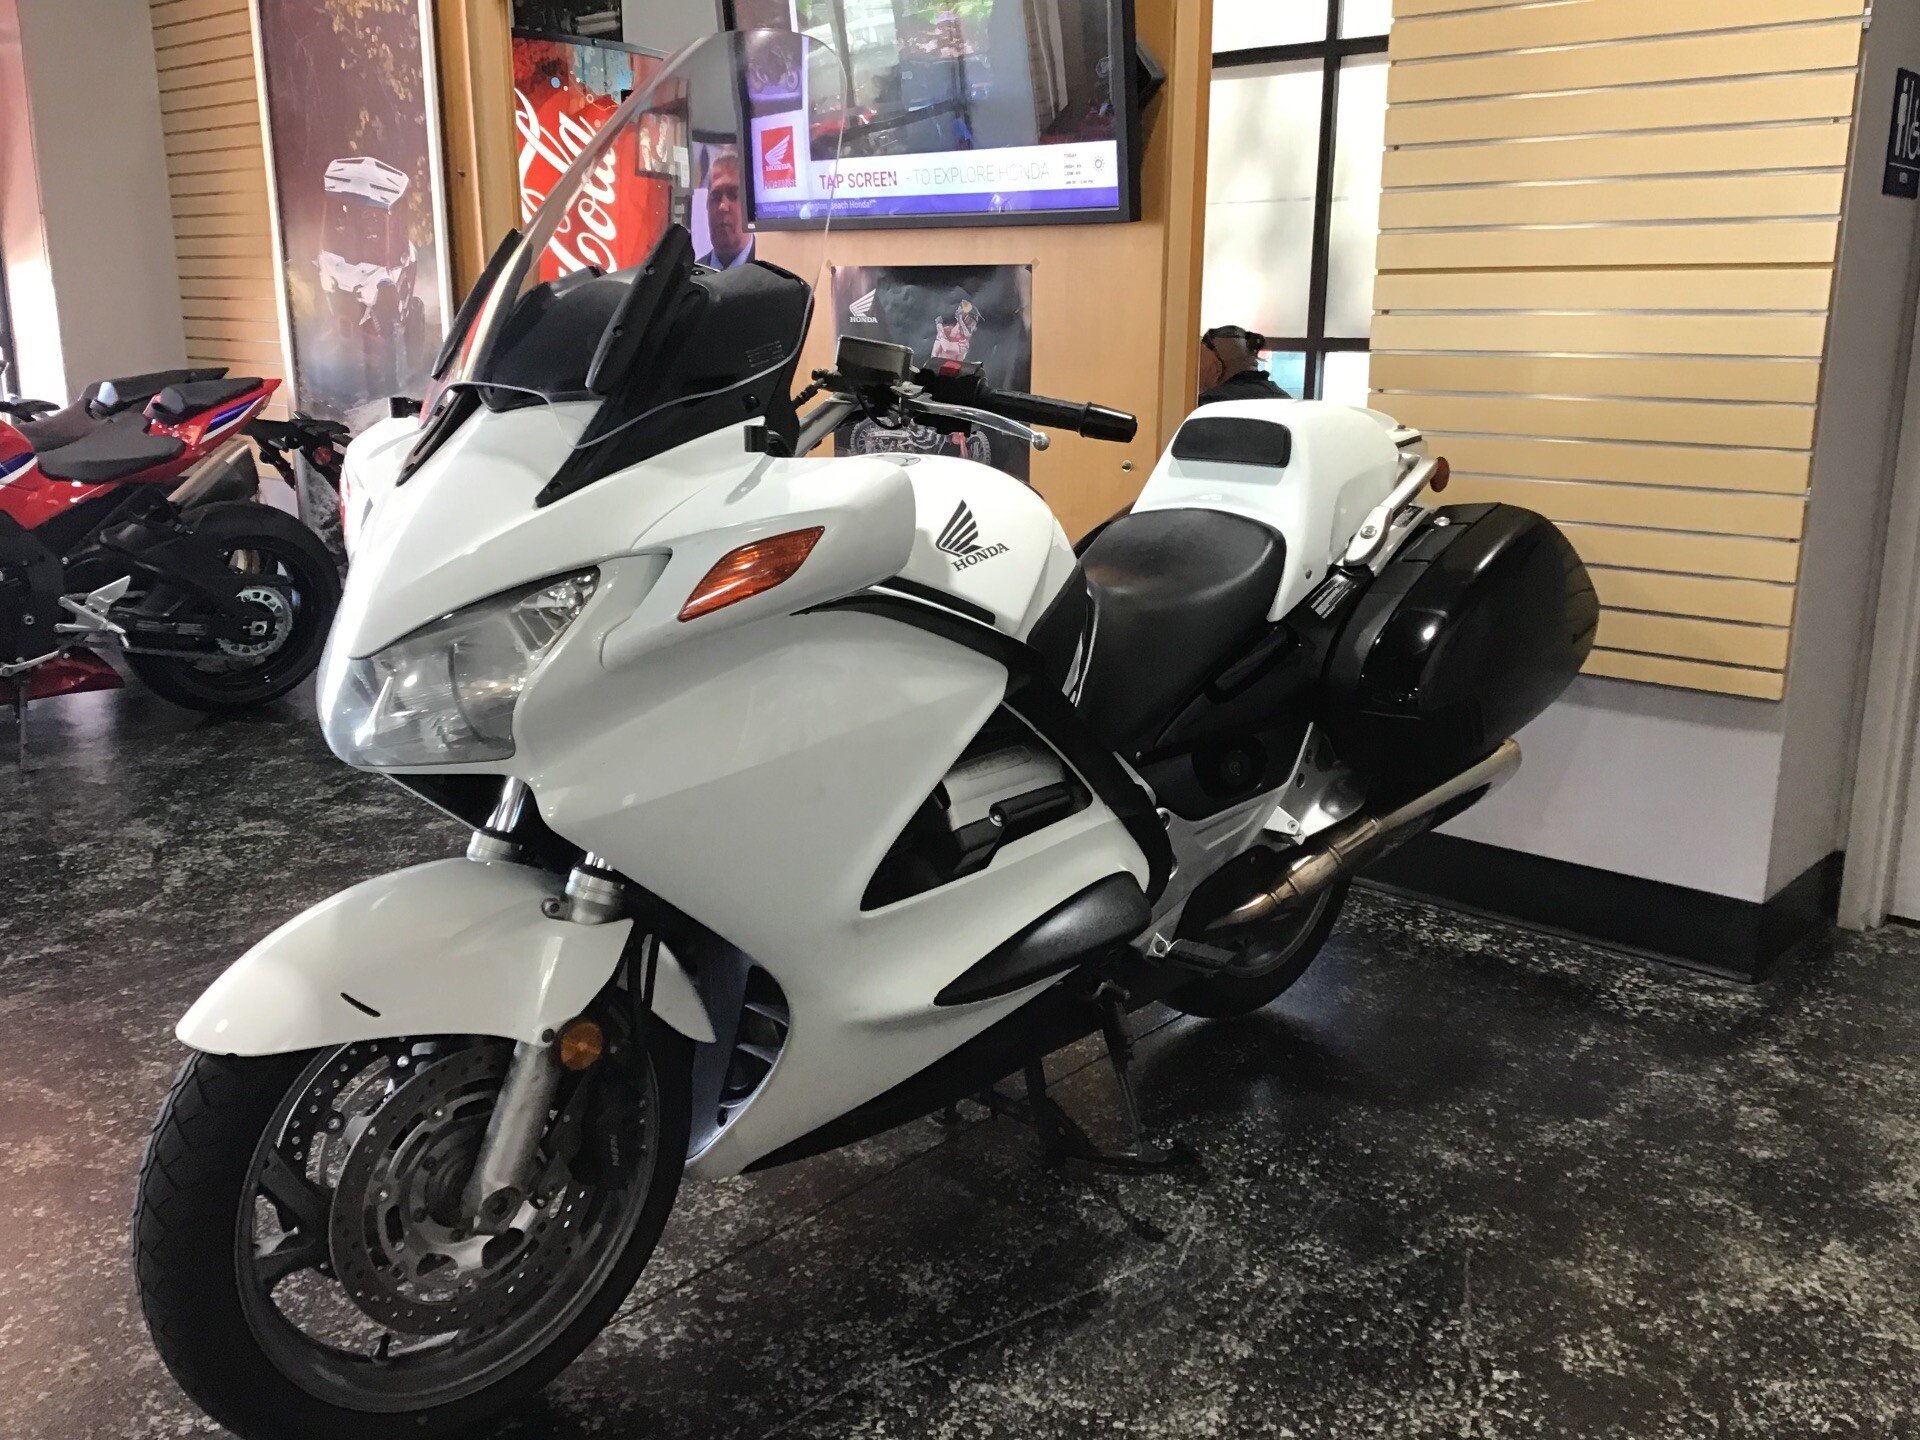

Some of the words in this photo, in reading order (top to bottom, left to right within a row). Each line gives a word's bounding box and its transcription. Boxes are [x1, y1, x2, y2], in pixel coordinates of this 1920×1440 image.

[766, 163, 793, 172] HONDA
[819, 172, 844, 190] TAP
[847, 171, 898, 188] SCREEN
[913, 168, 931, 185] TO
[933, 164, 994, 184] EXPLORE
[849, 316, 879, 324] HONDA
[951, 542, 1010, 572] HONDA
